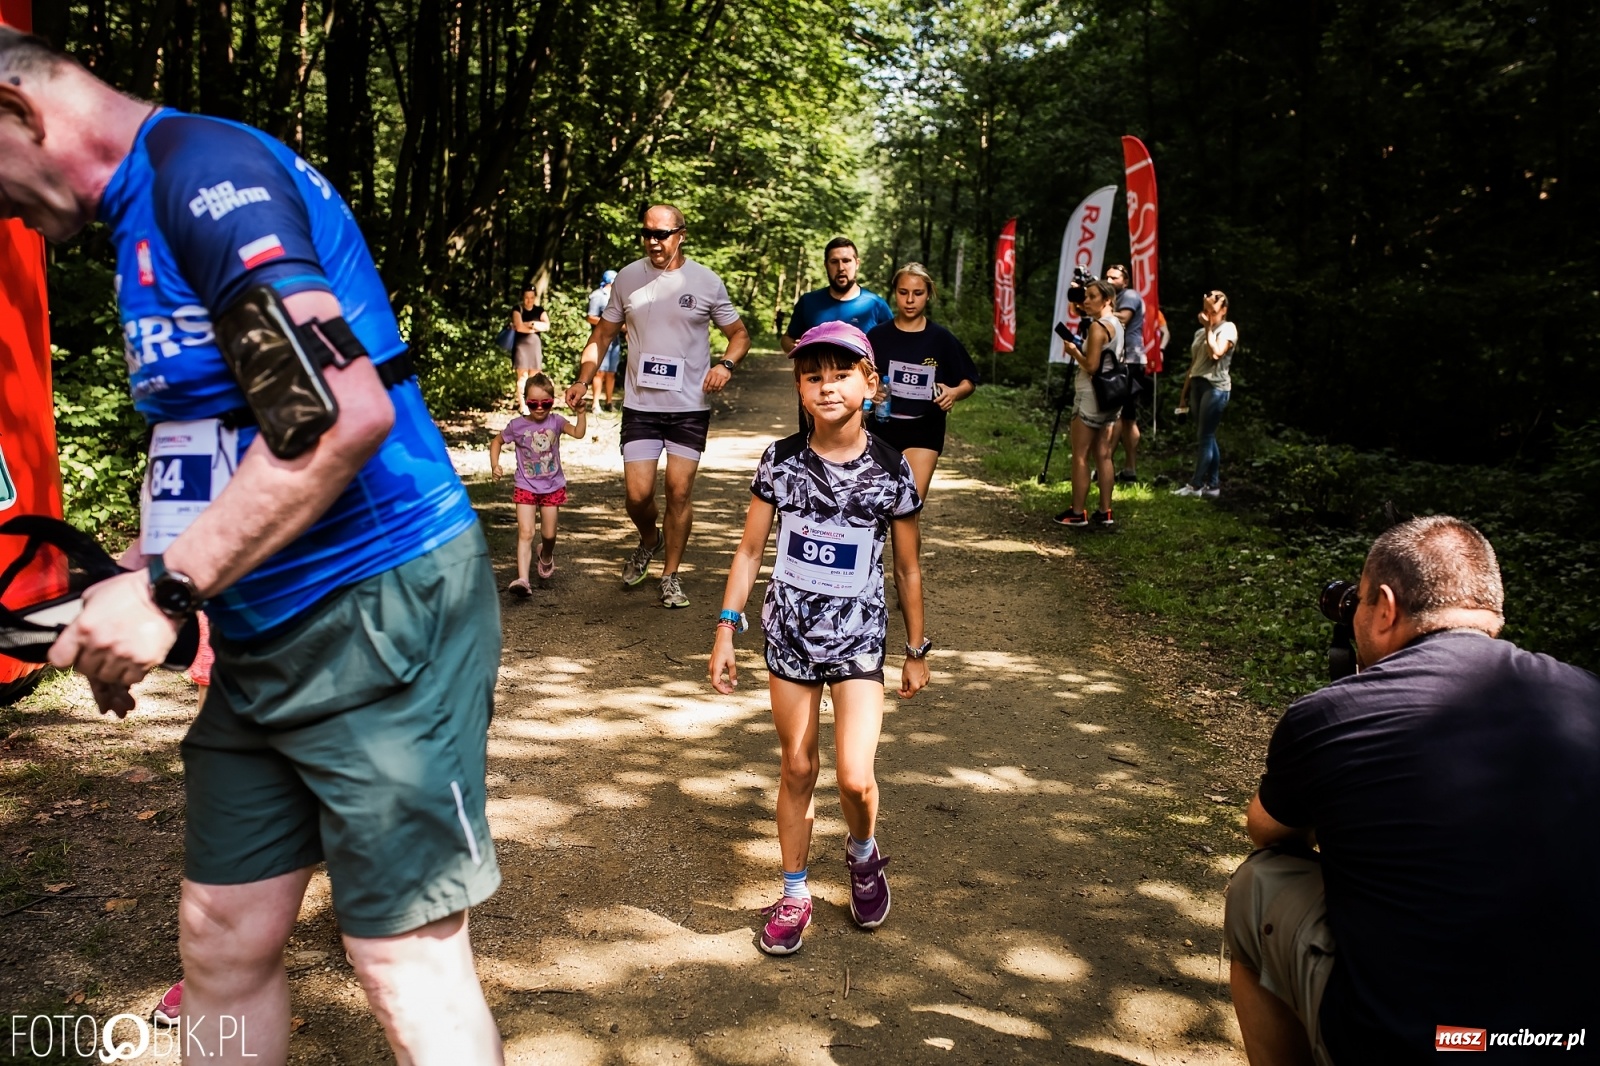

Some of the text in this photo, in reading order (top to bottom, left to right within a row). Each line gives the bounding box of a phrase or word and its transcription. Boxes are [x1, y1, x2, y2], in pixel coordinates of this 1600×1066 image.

[651, 363, 668, 375] 48
[902, 373, 919, 385] 88
[151, 458, 184, 496] 84
[802, 541, 836, 565] 96
